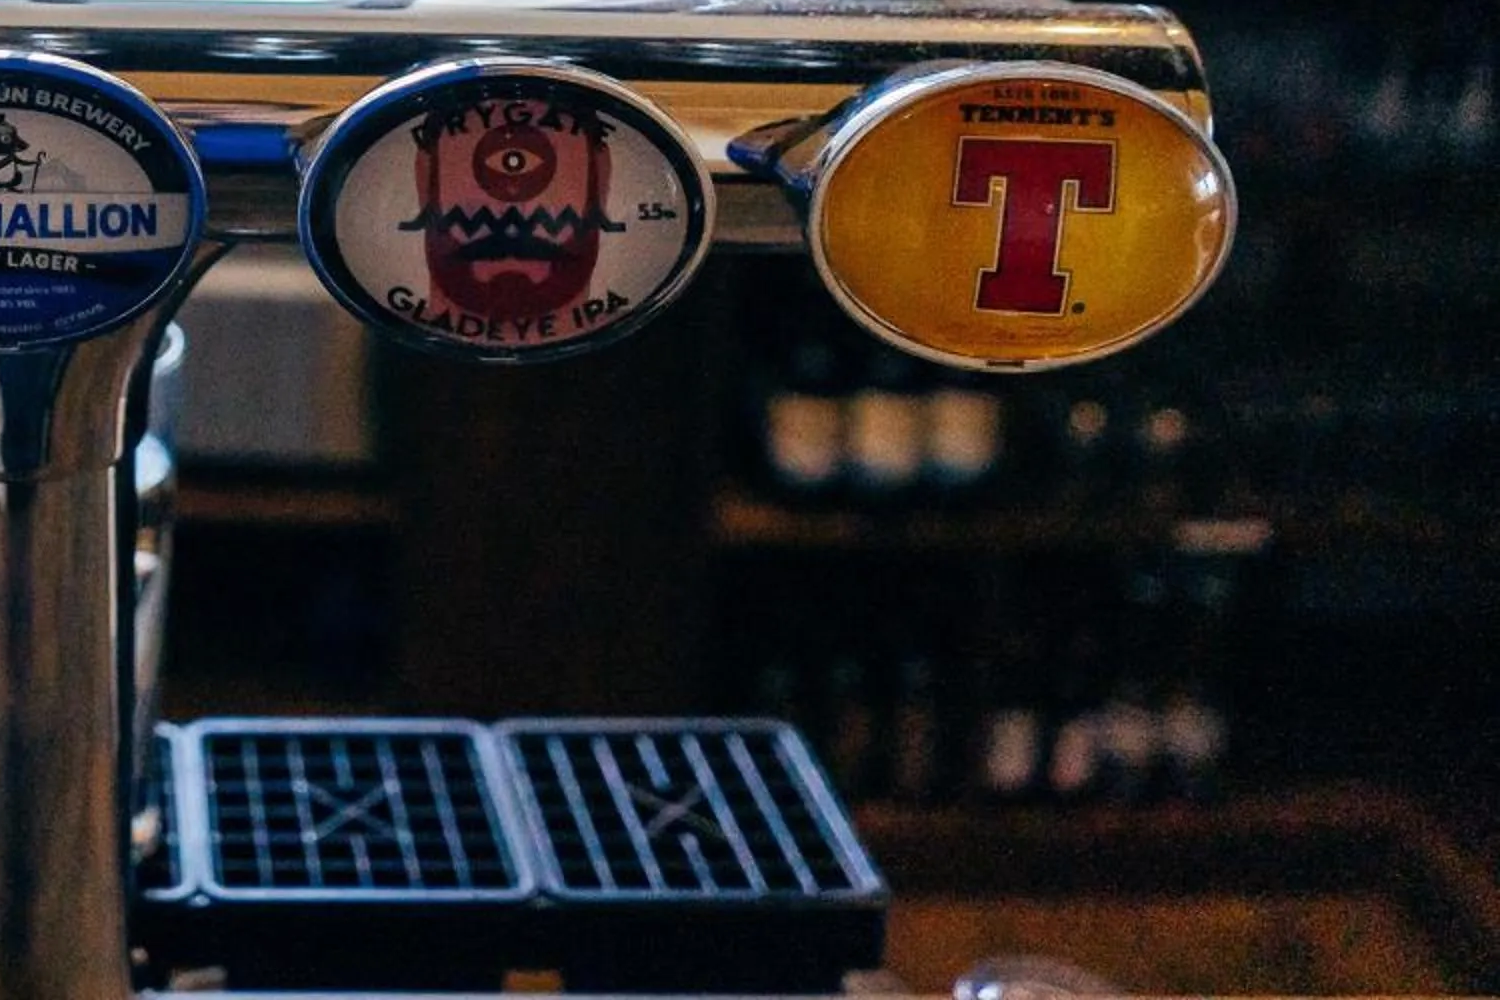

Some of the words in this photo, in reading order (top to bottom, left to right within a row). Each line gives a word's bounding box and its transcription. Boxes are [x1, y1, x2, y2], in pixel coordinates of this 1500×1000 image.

[35, 88, 153, 153] BREWERY
[958, 103, 1118, 127] TENNENT'S
[952, 134, 1118, 317] T
[7, 251, 80, 273] LAGER
[387, 286, 557, 340] GLADEYE
[573, 289, 631, 329] IPA
